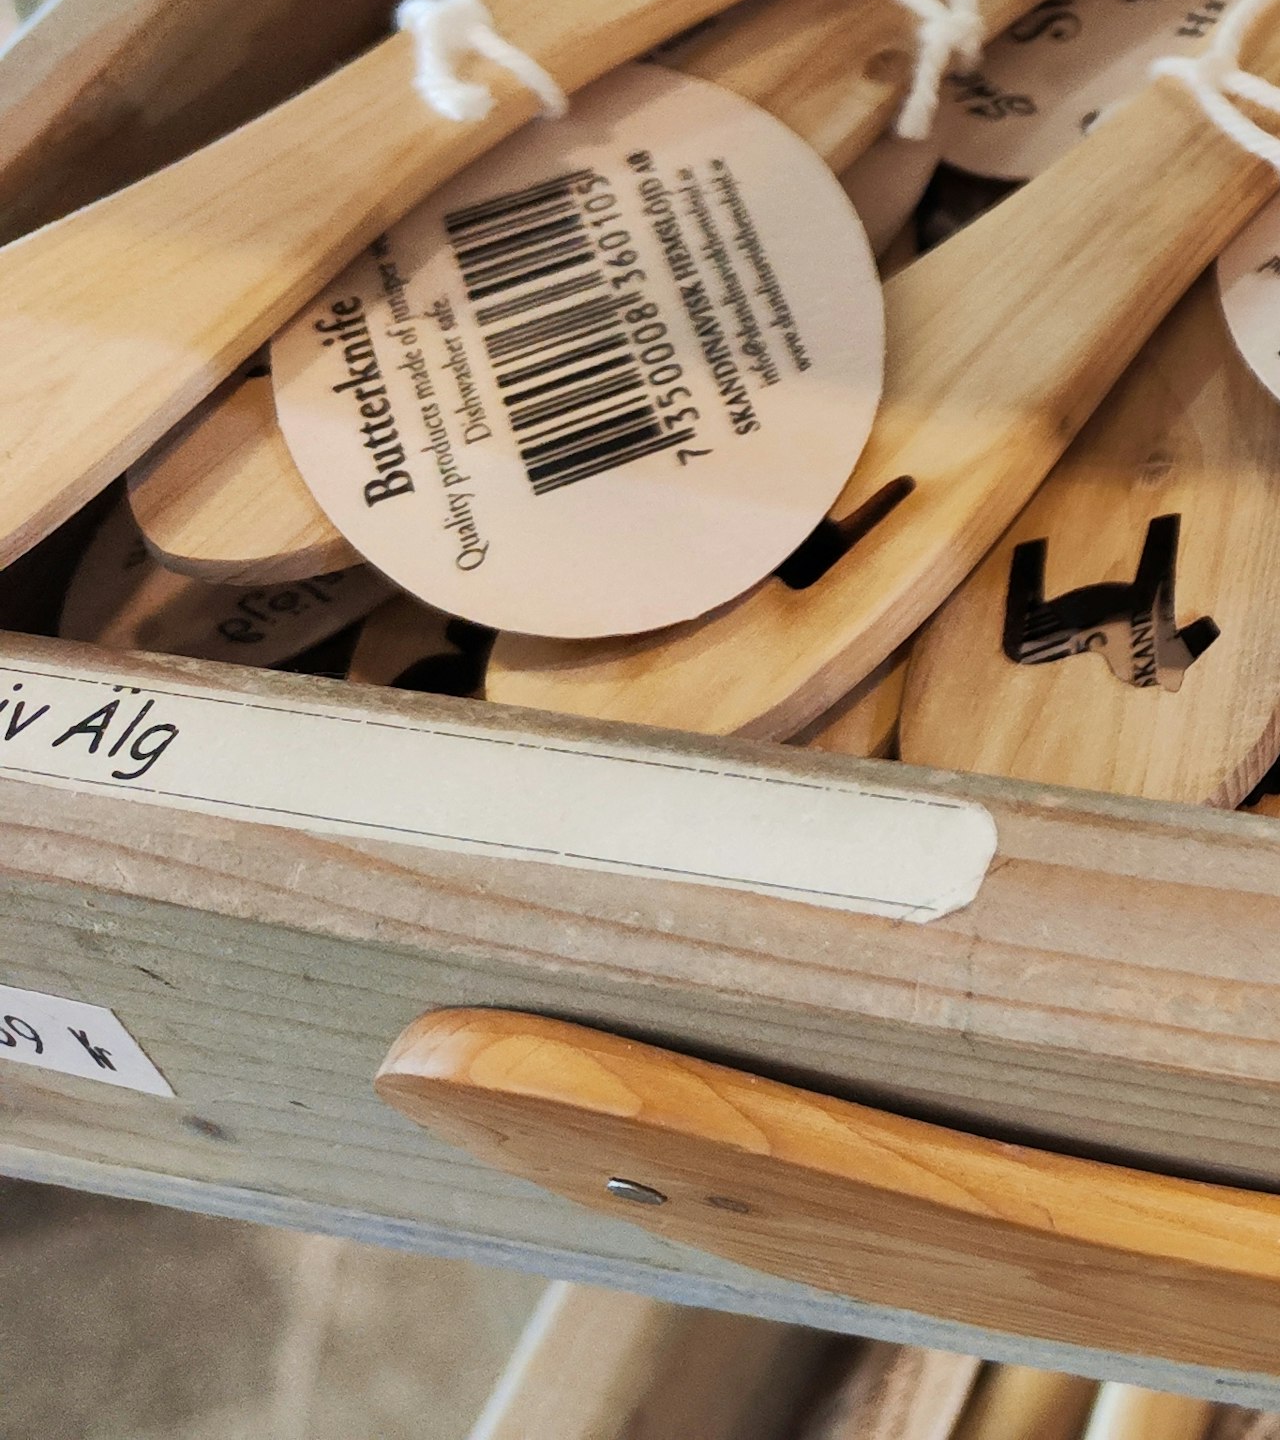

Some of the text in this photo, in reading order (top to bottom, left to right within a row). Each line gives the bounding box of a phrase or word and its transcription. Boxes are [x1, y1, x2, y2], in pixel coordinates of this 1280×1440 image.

[386, 325, 418, 347] of
[575, 174, 715, 467] 7 350008 360105
[679, 279, 762, 436] SKANDINAVISK
[315, 295, 417, 507] Butterknife
[396, 347, 436, 401] made
[441, 335, 493, 446] Dishwasher
[420, 402, 472, 489] products
[444, 491, 490, 572] Quality
[51, 683, 180, 781] Älg
